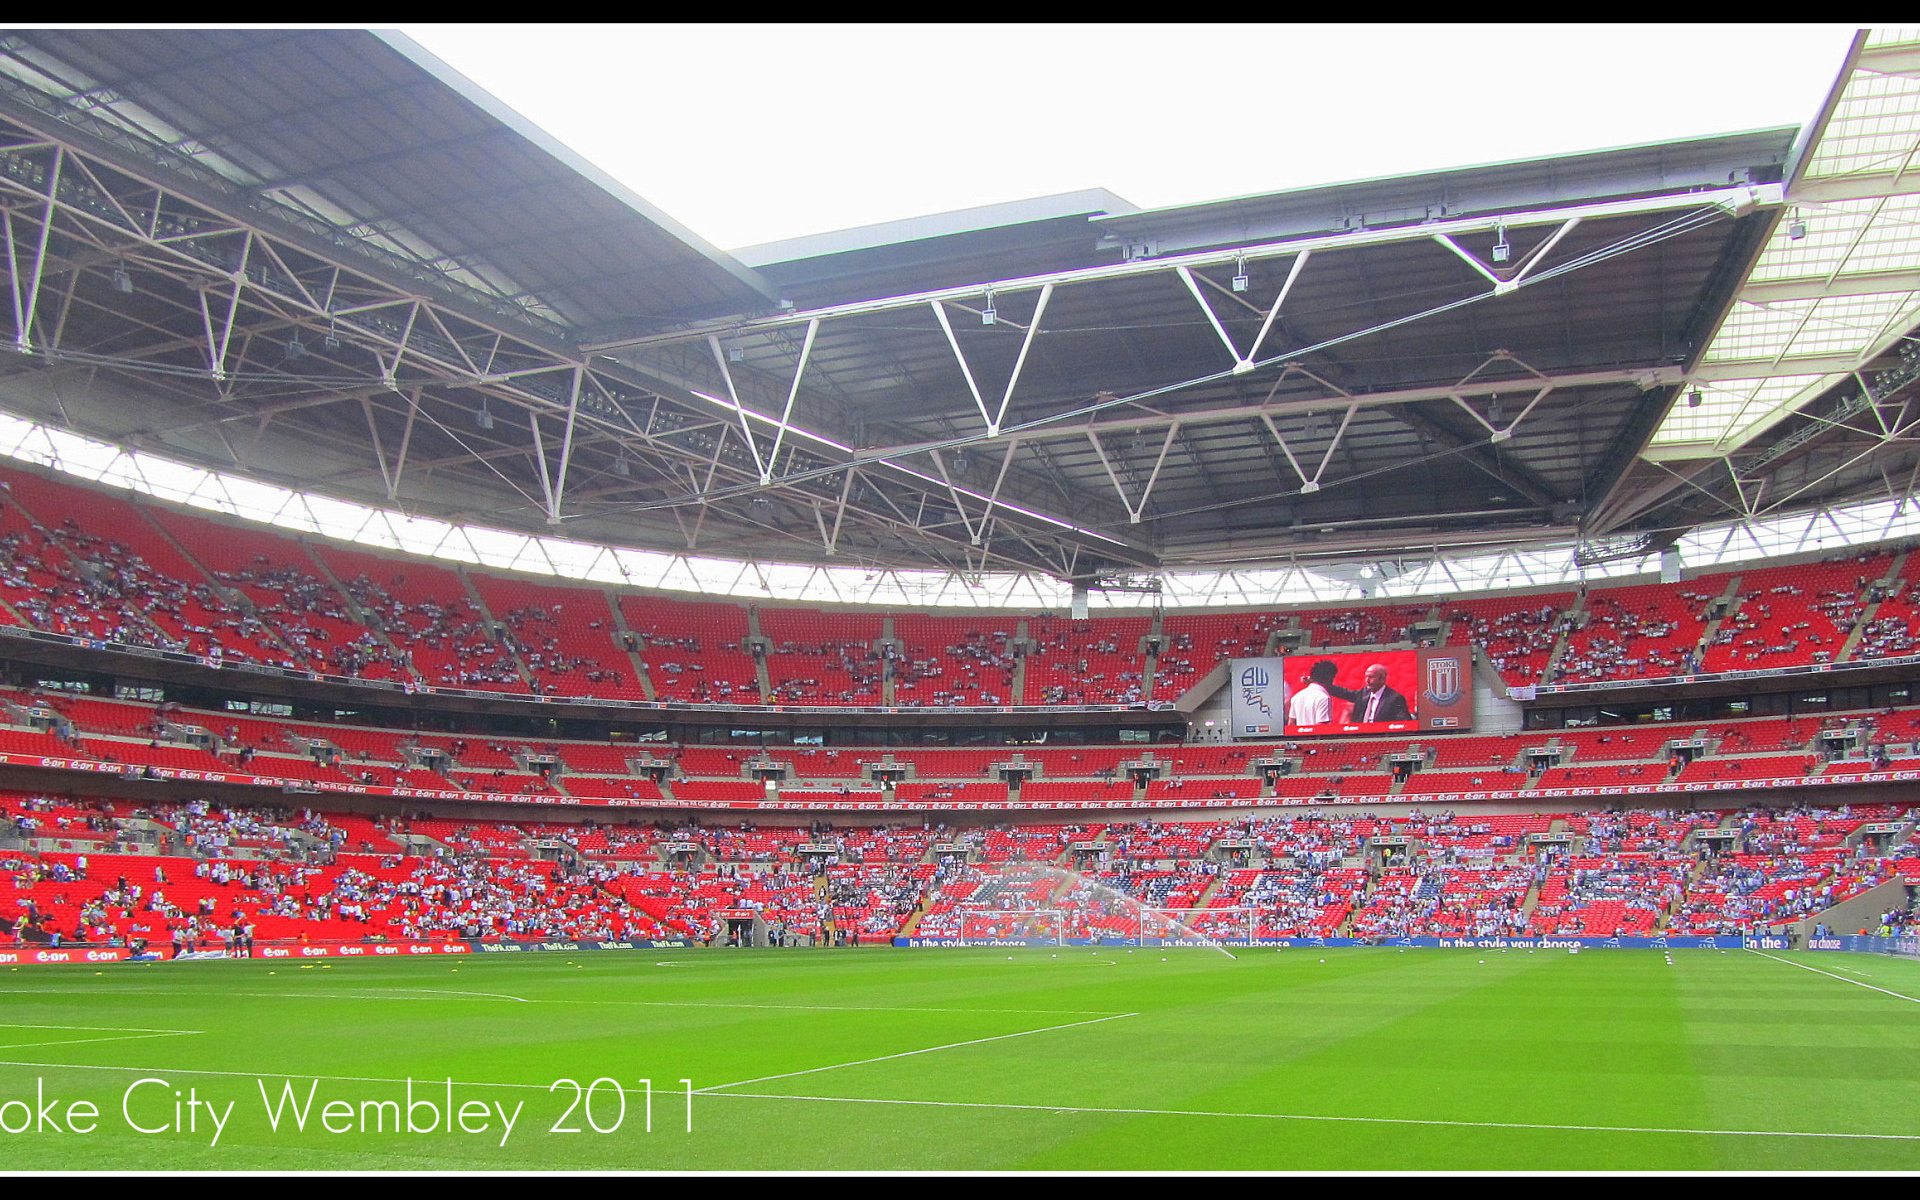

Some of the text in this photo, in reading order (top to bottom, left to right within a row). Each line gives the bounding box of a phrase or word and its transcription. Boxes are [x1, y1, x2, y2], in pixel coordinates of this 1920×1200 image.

[481, 943, 521, 952] TheFA.com
[651, 940, 685, 948] TheFA.com
[909, 938, 919, 947] In
[922, 938, 939, 947] the
[989, 938, 1026, 947] choose
[1162, 938, 1171, 947] In
[1174, 938, 1192, 947] the
[1250, 938, 1290, 947] choose
[1439, 938, 1450, 948] In
[1453, 938, 1475, 947] the
[1478, 938, 1506, 948] style
[1537, 938, 1581, 948] choose
[1761, 937, 1781, 949] the
[1818, 936, 1841, 949] choose
